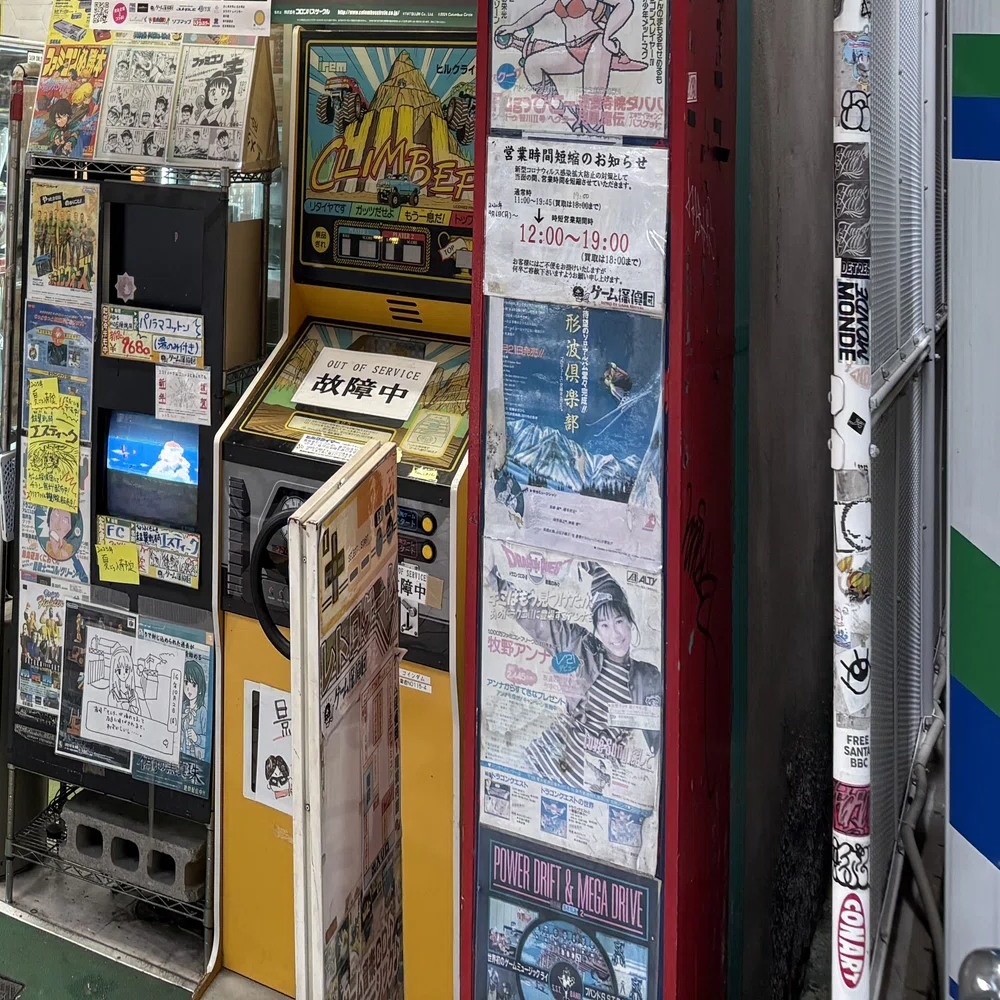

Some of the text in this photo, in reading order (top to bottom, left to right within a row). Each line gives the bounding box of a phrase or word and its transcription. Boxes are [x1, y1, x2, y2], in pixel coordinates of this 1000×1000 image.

[318, 56, 347, 72] irem
[436, 63, 475, 75] ヒルクライ
[503, 145, 648, 169] 営業時間短縮のお知らせ
[514, 188, 532, 196] 通常時
[309, 202, 446, 225] リタイヤです ガッツだせよ もう一息だ!
[590, 284, 655, 307] ゲーム探偵団
[140, 313, 190, 333] パノラマコットン
[838, 281, 856, 364] MONDE
[855, 284, 870, 361] MONDE
[327, 359, 421, 381] OUT OF SERVICE
[563, 306, 582, 434] 形波倶楽部
[310, 373, 410, 405] 故障中
[106, 525, 125, 539] FC
[406, 568, 428, 582] SERVICE
[639, 576, 657, 586] ALTY
[398, 577, 427, 600] 障中
[487, 636, 550, 664] 牧野アンナ
[486, 678, 566, 705] アンナからすてきなプレゼント
[846, 735, 869, 746] FREE
[850, 757, 868, 768] BBC
[493, 845, 643, 929] POWER DRIFT & MEGA DRIVE
[839, 897, 865, 987] CONART
